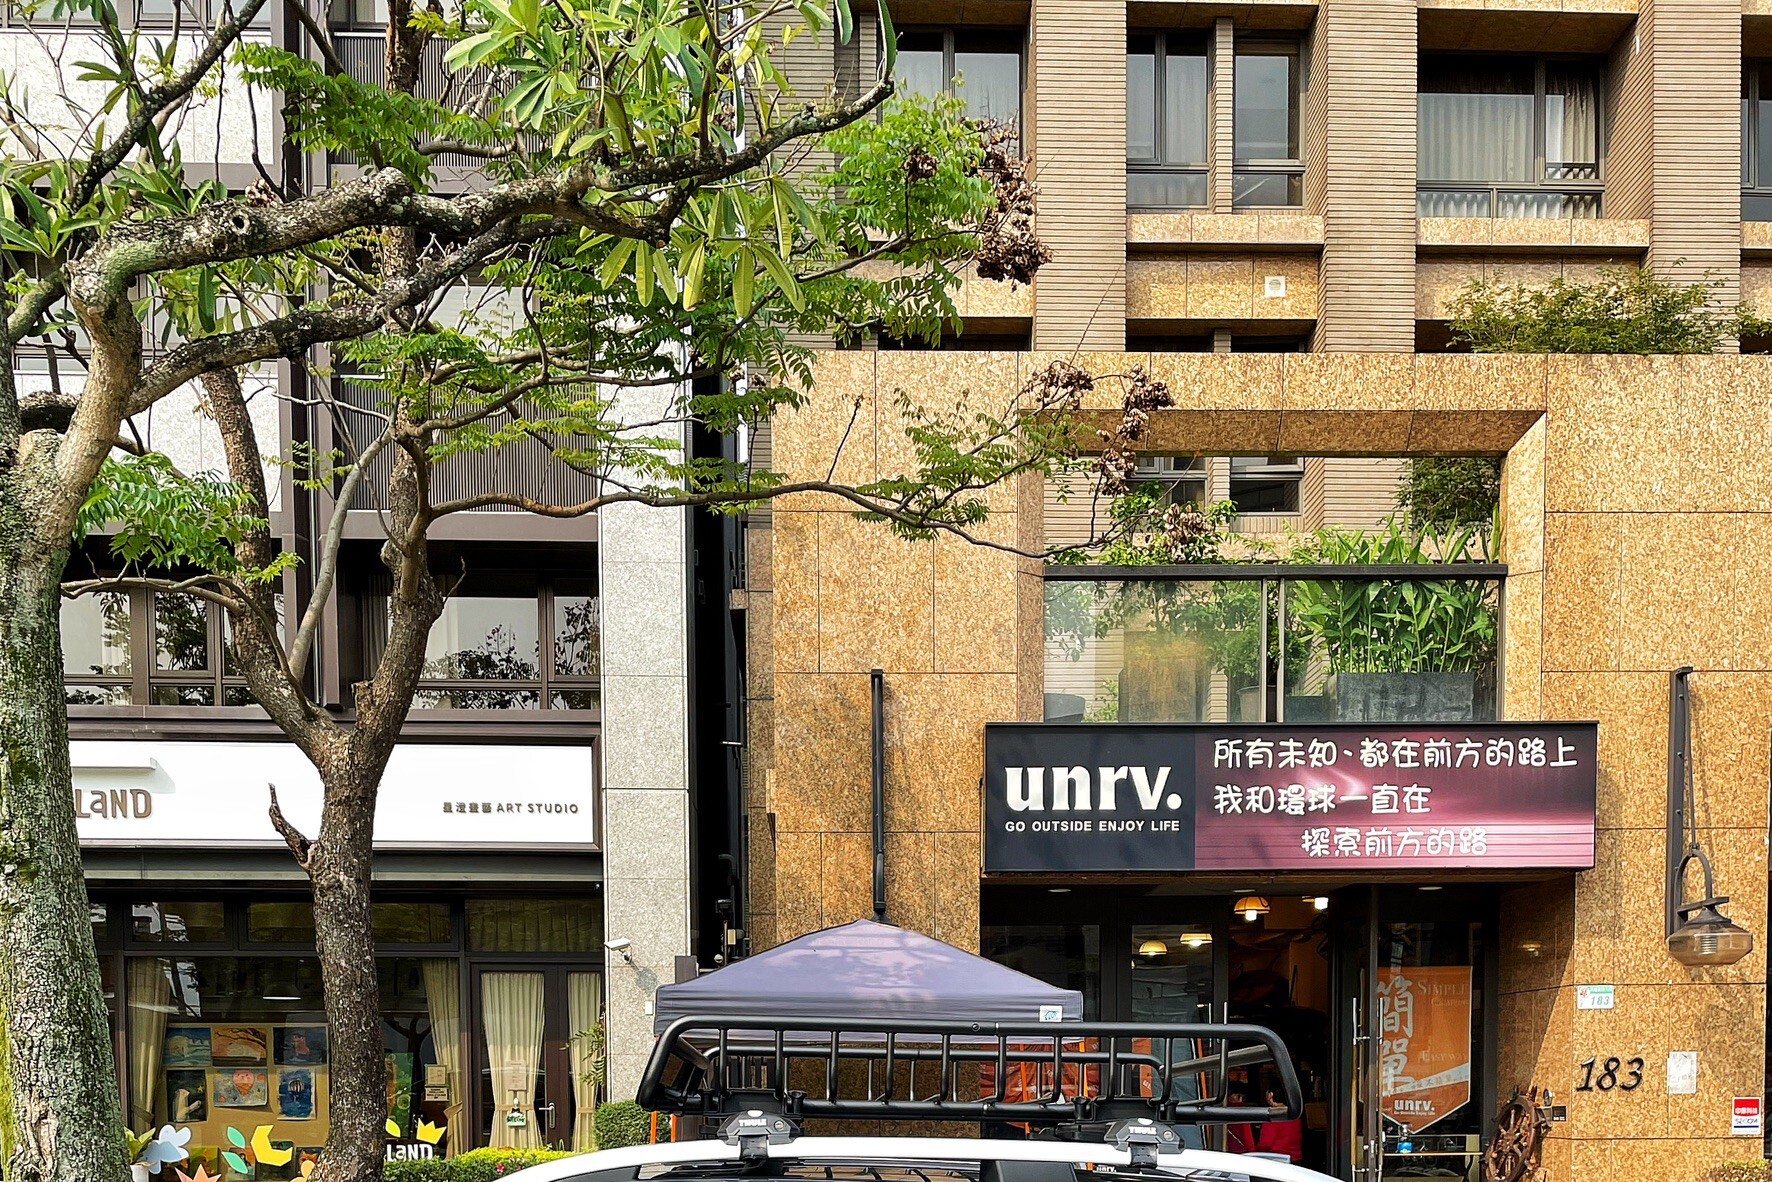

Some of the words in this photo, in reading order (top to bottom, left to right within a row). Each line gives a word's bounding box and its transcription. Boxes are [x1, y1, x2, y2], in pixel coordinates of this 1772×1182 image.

[1214, 737, 1578, 768] 所有未知、都在前方的路上
[1005, 766, 1182, 811] unrv.
[1214, 783, 1432, 815] 我和環球一直在
[496, 803, 523, 813] ART
[527, 803, 579, 814] STUDIO
[1005, 821, 1026, 832] GO
[1031, 820, 1092, 832] OUTSIDE
[1099, 820, 1145, 832] ENJOY
[1151, 820, 1180, 832] LIFE
[1301, 827, 1488, 858] 探索前方的路
[1591, 995, 1610, 1005] 183
[1576, 1057, 1645, 1092] 183
[1394, 1099, 1436, 1111] unrv.
[738, 1118, 767, 1127] THULE
[1128, 1126, 1157, 1135] THULE
